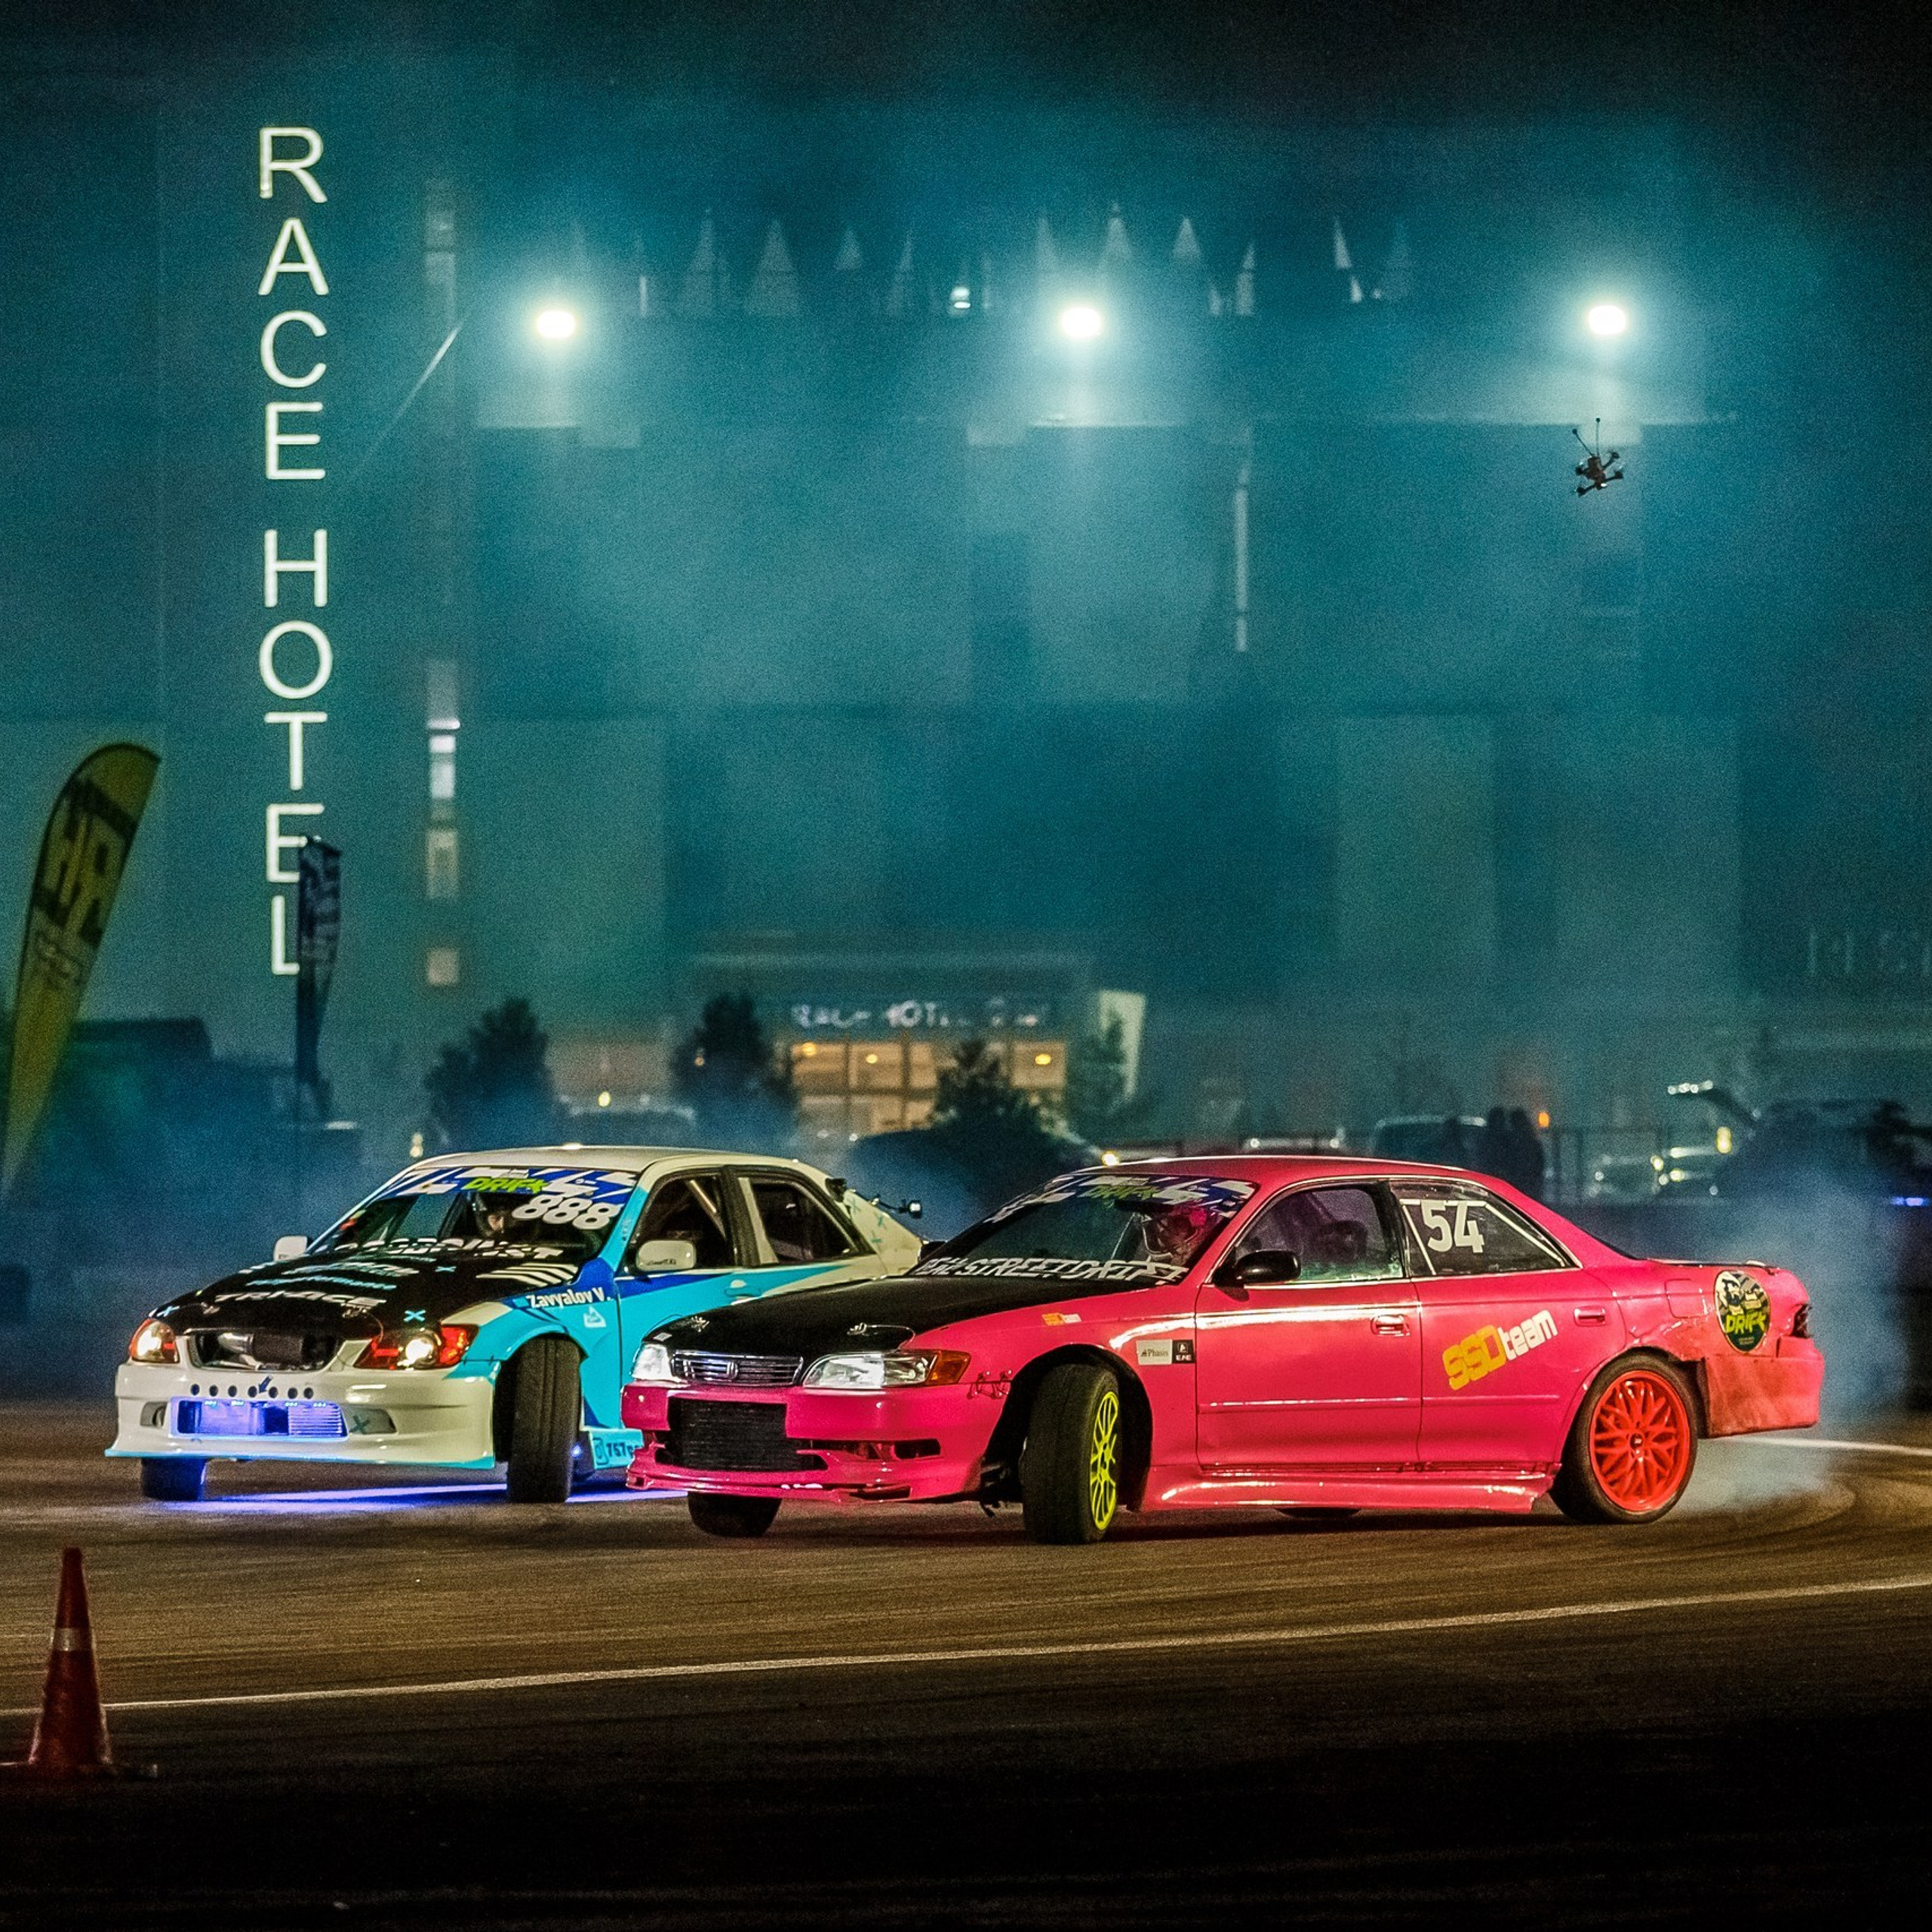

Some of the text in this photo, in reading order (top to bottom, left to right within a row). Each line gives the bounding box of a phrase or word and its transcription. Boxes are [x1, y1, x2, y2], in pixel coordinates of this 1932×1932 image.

[257, 125, 330, 481] RACE
[258, 528, 333, 976] HOTEL
[511, 1194, 622, 1230] 888
[1420, 1199, 1485, 1254] 54
[525, 1288, 593, 1310] Zavyalov
